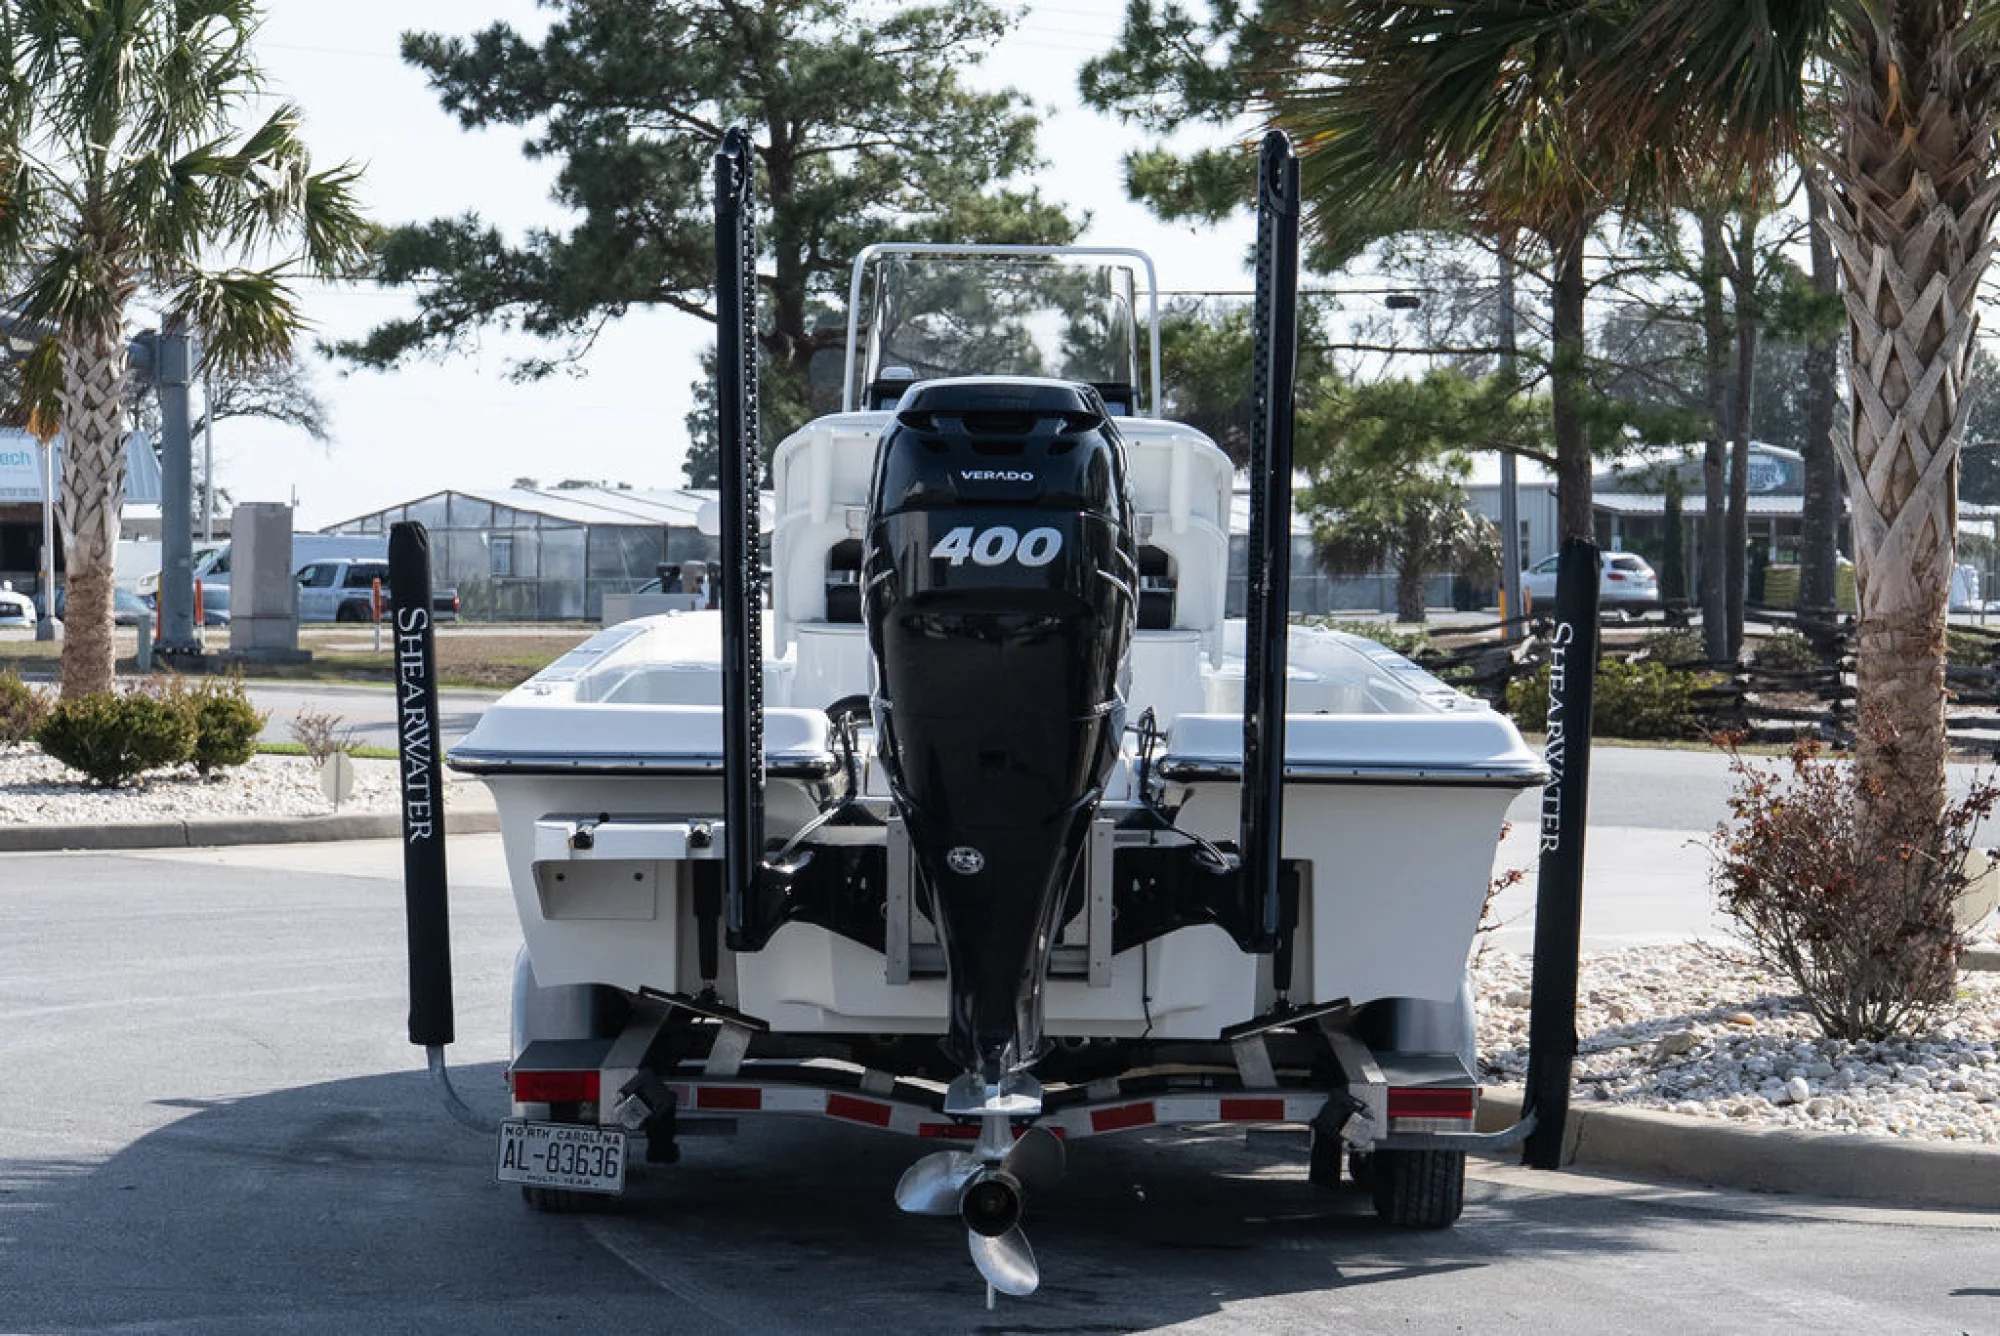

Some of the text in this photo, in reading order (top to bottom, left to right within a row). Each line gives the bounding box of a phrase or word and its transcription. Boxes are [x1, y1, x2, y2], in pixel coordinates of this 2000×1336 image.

[961, 470, 1035, 482] VERADO
[929, 525, 1064, 568] 400
[398, 607, 433, 844] SHEARWATER
[1540, 622, 1574, 853] SHEARWATER
[505, 1126, 620, 1146] NORTH CAROLINA
[503, 1138, 620, 1179] AL-83636
